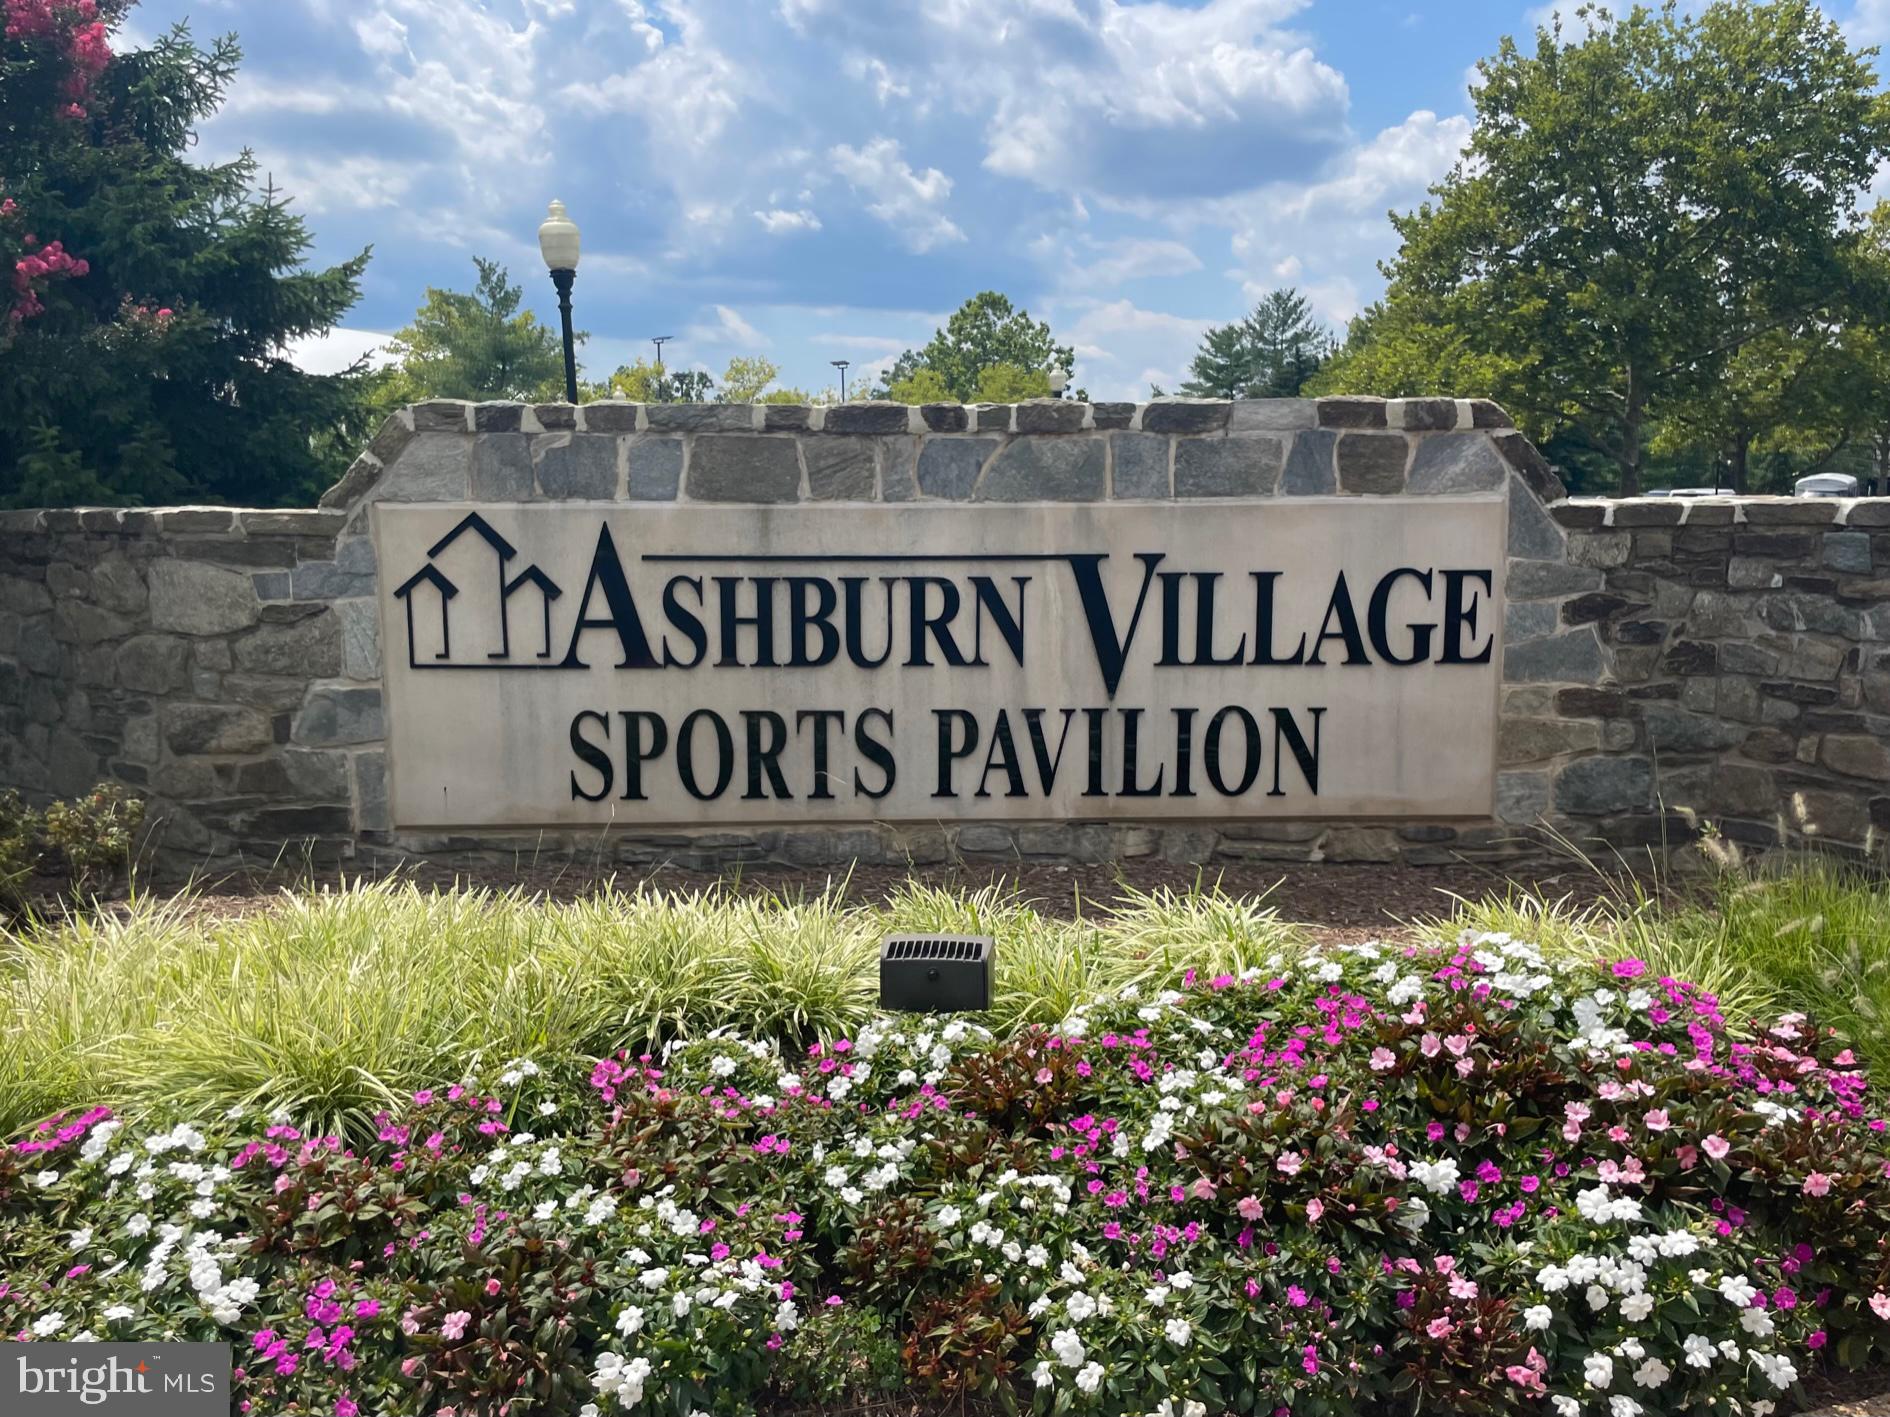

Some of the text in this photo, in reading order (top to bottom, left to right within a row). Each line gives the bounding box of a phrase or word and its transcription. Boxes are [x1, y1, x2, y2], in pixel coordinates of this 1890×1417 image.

[557, 520, 1494, 702] ASHBURN VILLAGE
[569, 705, 1328, 803] SPORTS PAVILION
